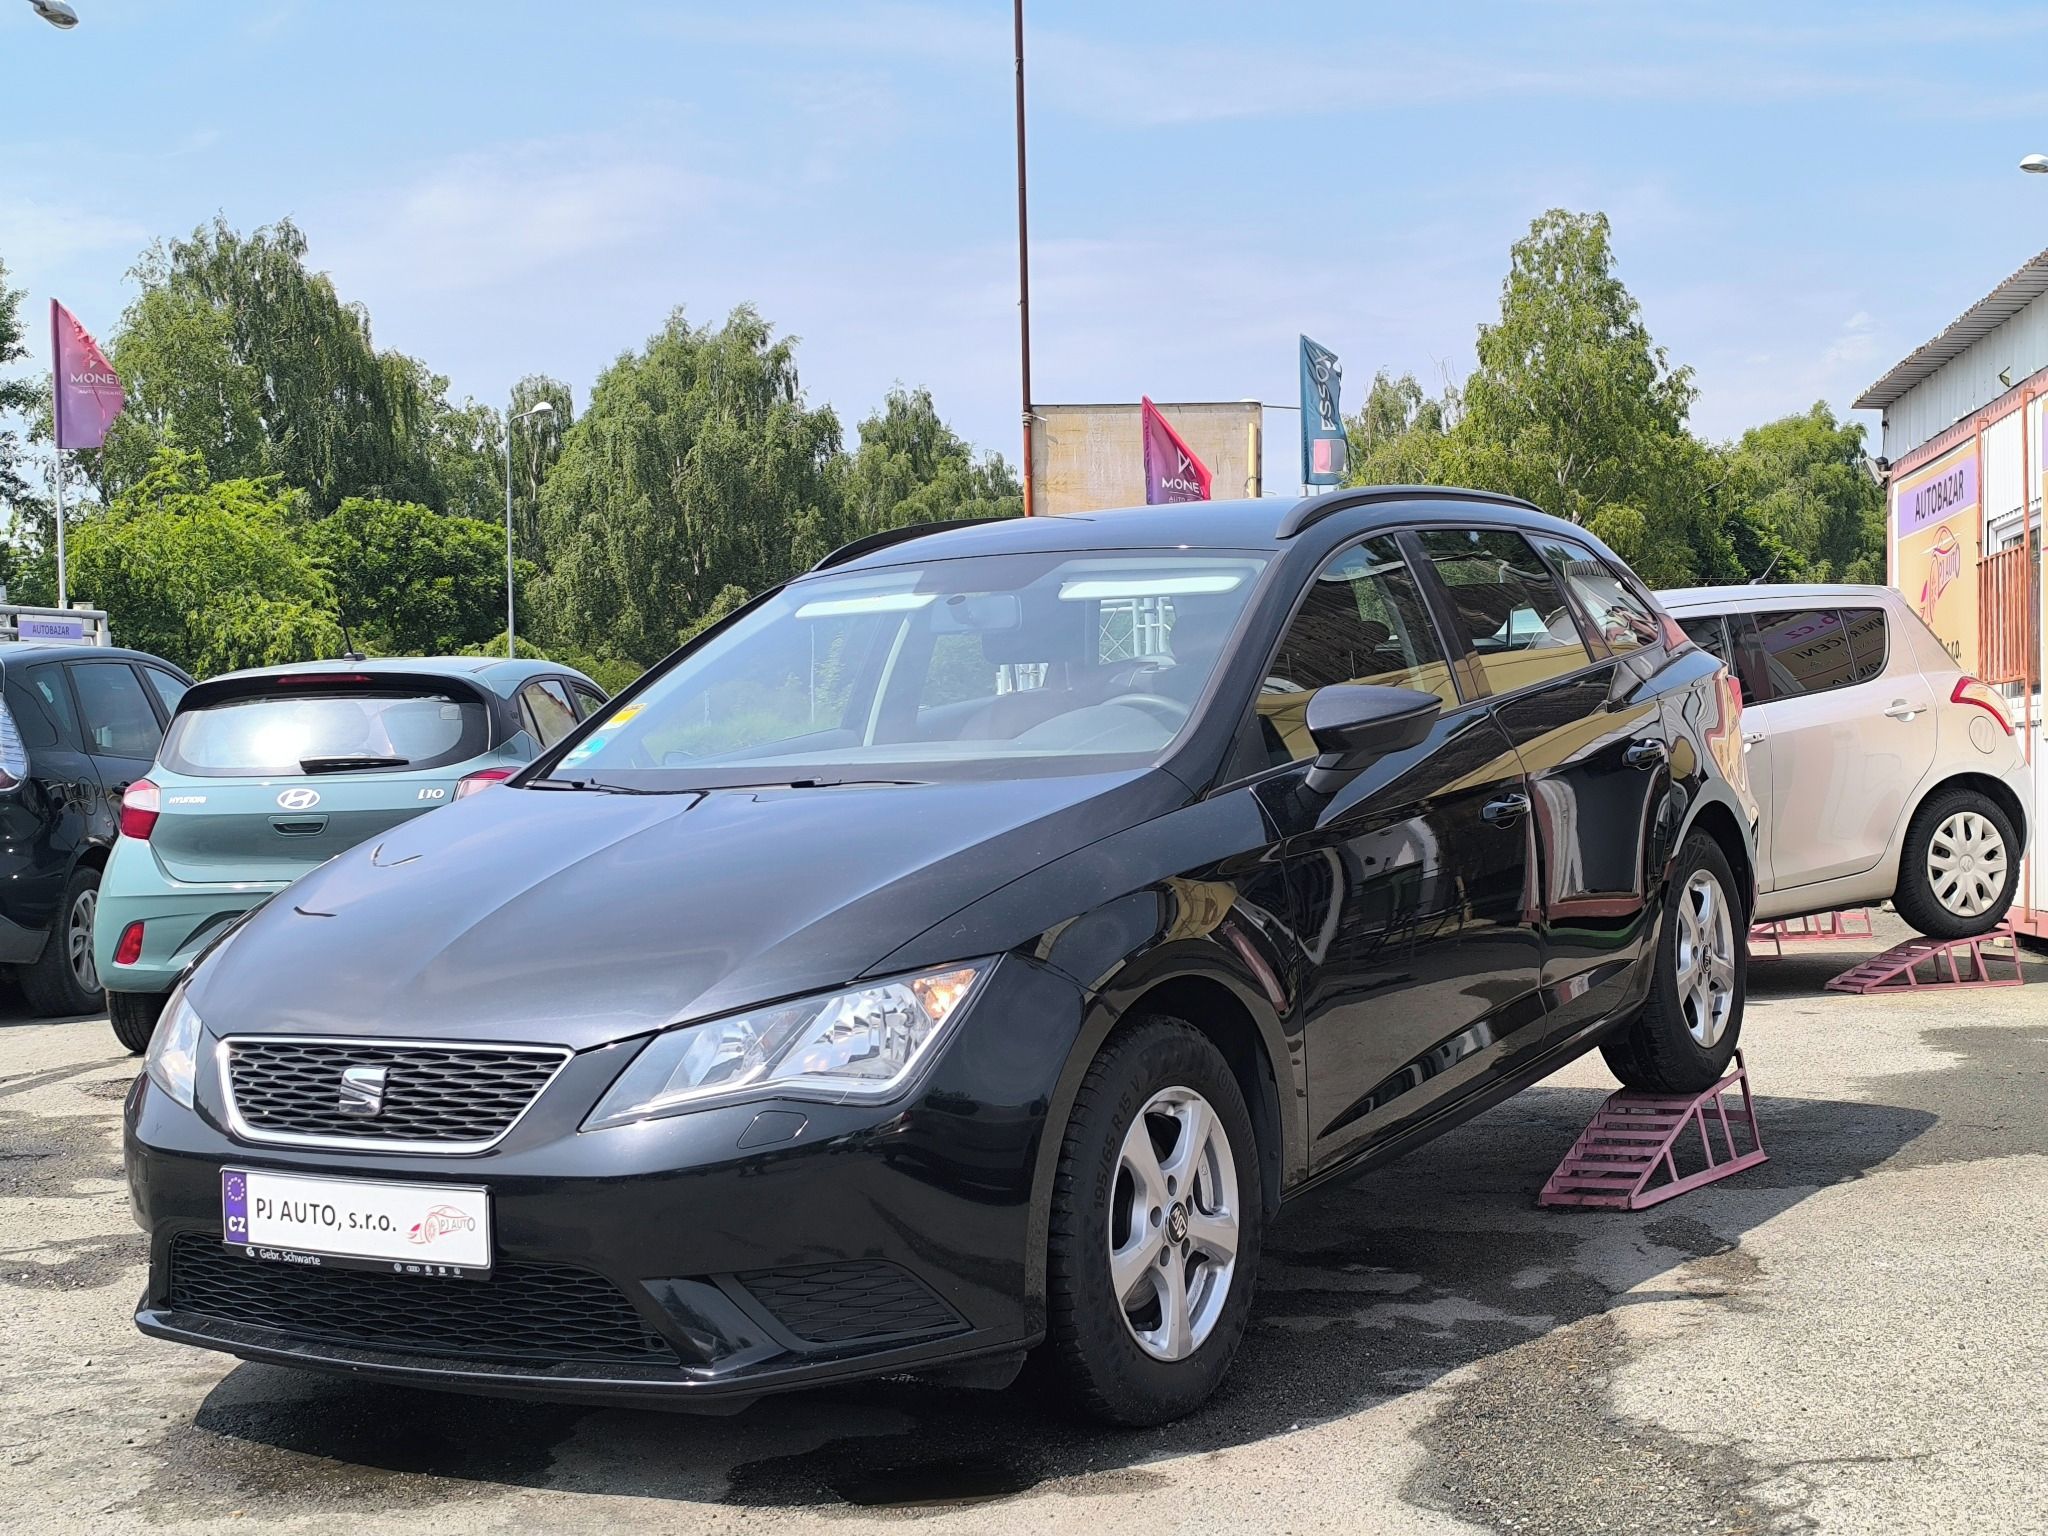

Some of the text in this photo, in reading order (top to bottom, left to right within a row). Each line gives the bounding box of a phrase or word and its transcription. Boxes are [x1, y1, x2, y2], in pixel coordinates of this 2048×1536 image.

[70, 372, 120, 384] MONET
[1914, 469, 1964, 522] AUTOBAZAR
[32, 625, 70, 636] AUTOBAZAR
[168, 795, 206, 805] HYUNDAI
[256, 1198, 397, 1232] PJ AUTO, s.r.o.
[228, 1215, 246, 1233] CZ
[451, 1217, 476, 1232] AUTO
[259, 1249, 282, 1261] Gebr.
[283, 1252, 321, 1266] Schwarte
